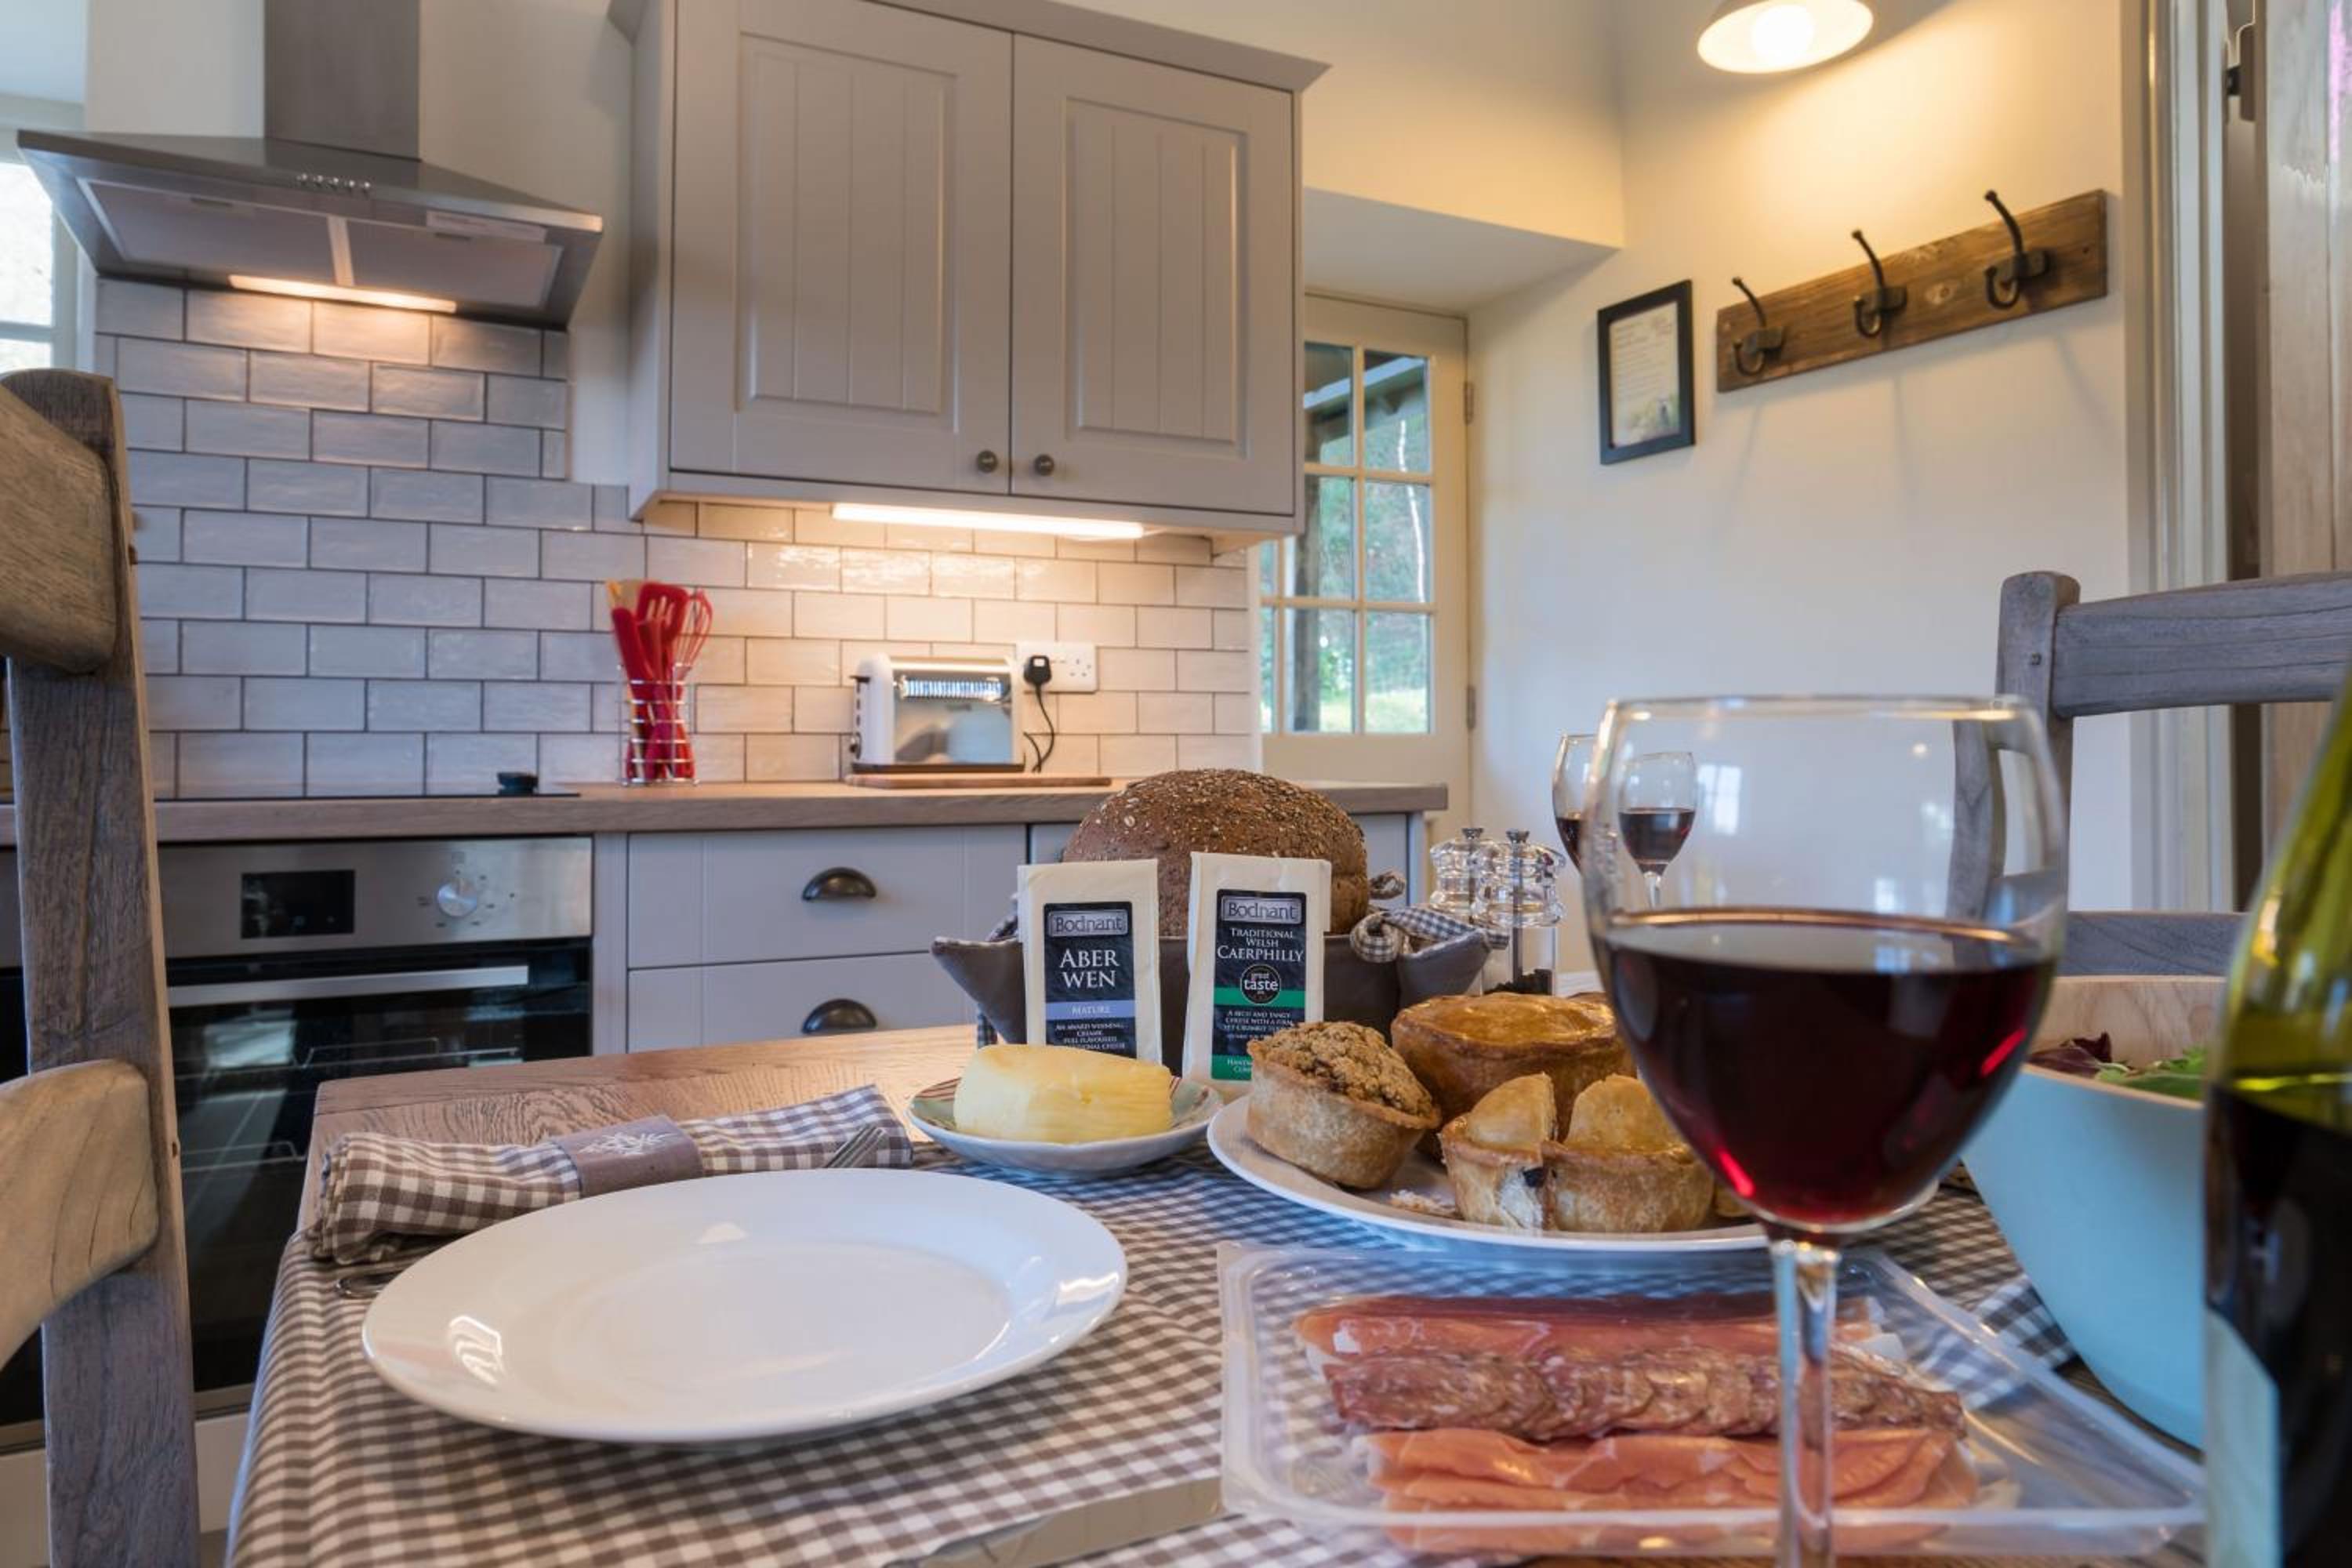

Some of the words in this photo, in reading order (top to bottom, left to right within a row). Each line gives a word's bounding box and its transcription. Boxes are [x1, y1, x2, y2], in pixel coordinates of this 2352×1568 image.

[1229, 902, 1297, 920] Bodnant
[1056, 915, 1123, 933] Bodnant
[1230, 927, 1293, 938] TRADITIONAL
[1246, 937, 1279, 948] WELSH
[1059, 948, 1120, 968] ABER
[1218, 945, 1303, 962] CAERPHILLY
[1062, 970, 1116, 989] WEN
[1243, 979, 1279, 992] taste
